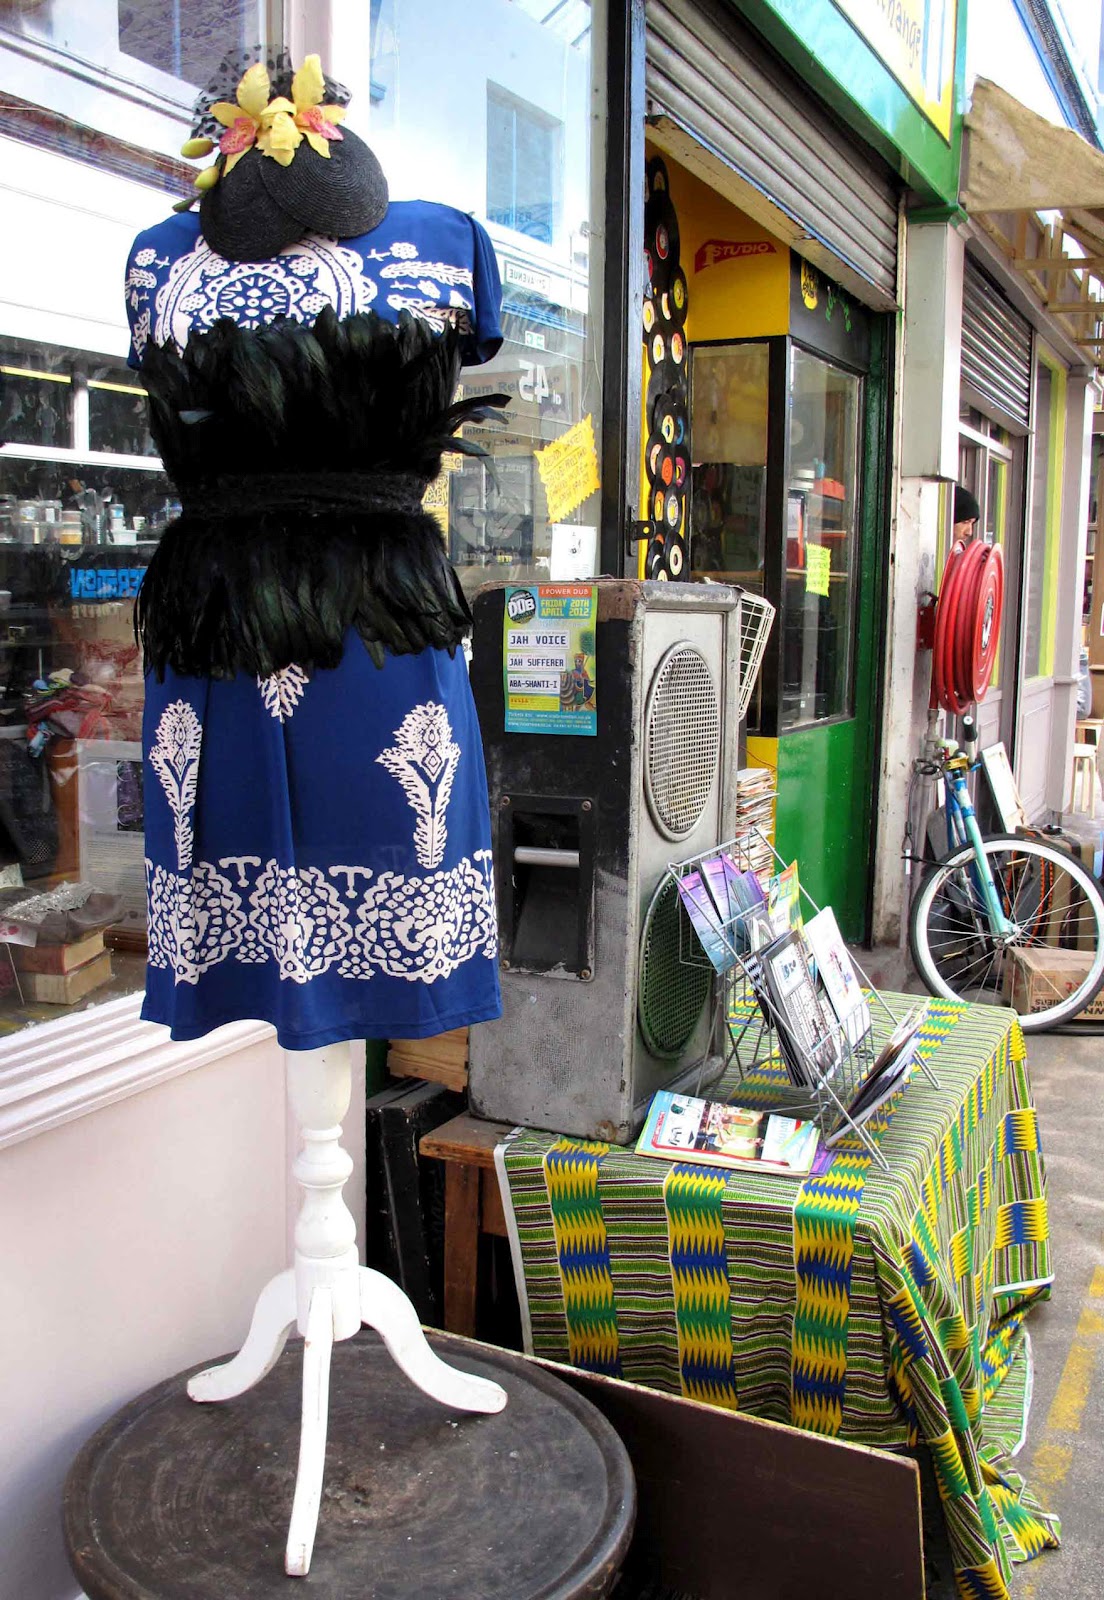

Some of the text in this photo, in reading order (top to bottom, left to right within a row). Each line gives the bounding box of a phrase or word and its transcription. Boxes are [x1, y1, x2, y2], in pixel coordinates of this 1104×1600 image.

[508, 598, 536, 618] DUB
[540, 599, 590, 608] FRIDAY 20TH
[540, 607, 565, 617] APRIL
[568, 607, 589, 617] 2012
[510, 635, 567, 645] JAH VOICE
[509, 658, 564, 667] JAH SUFFERER
[509, 679, 558, 689] ABA-SHANTI-I
